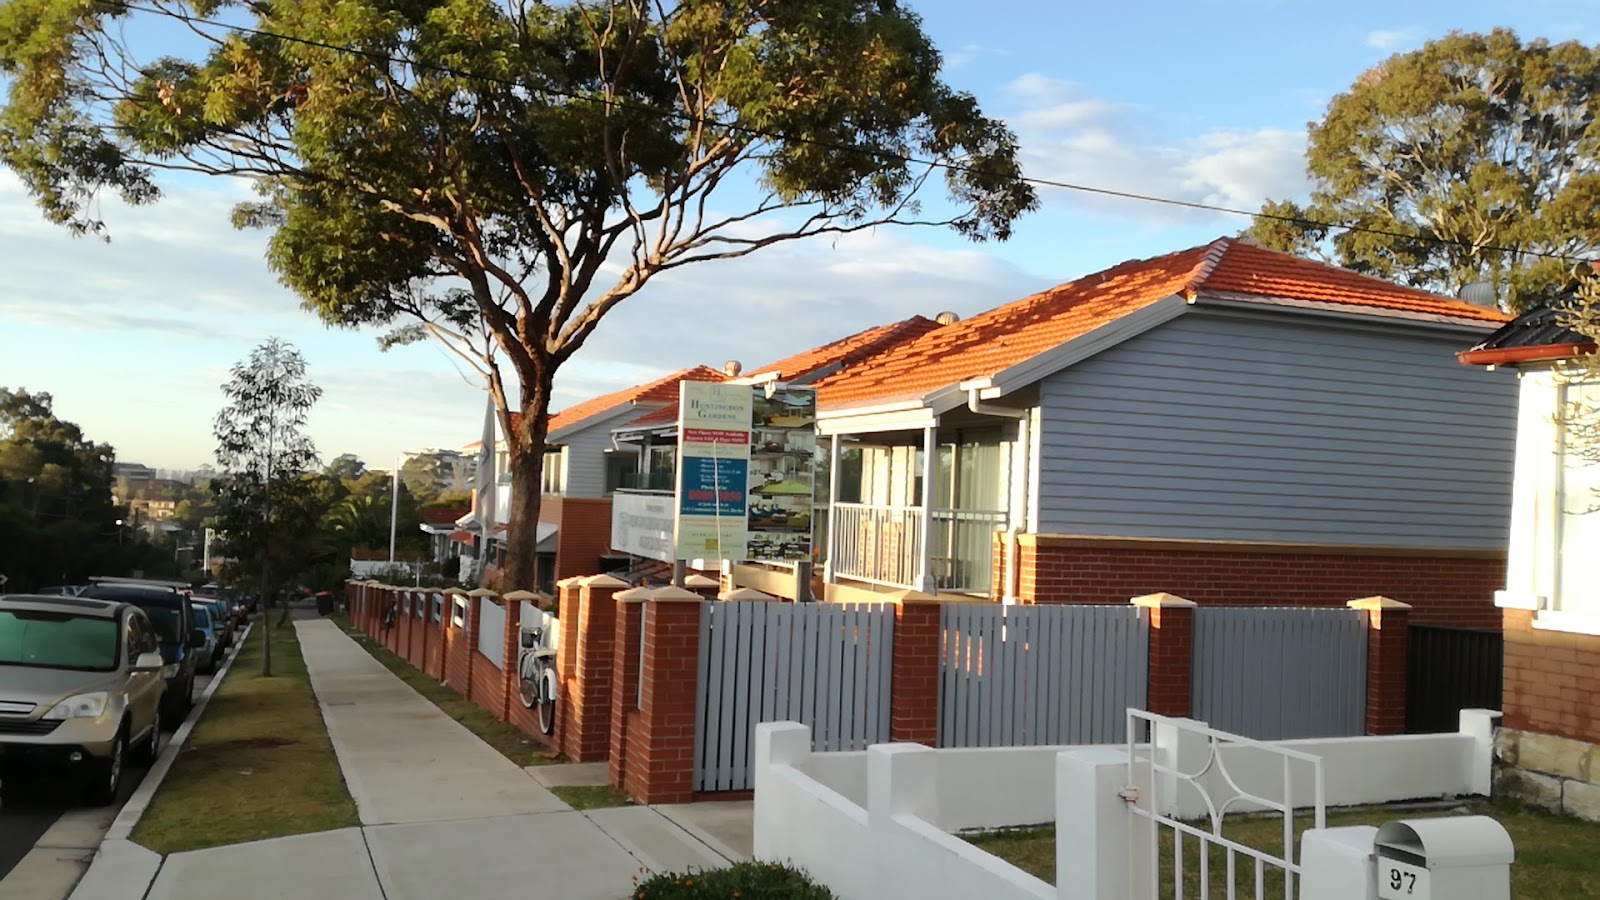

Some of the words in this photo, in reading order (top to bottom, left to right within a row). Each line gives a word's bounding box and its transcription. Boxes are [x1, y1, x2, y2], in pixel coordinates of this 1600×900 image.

[691, 400, 744, 411] HUNTINGDON
[698, 409, 736, 419] GARDENS
[1390, 868, 1416, 894] 97
